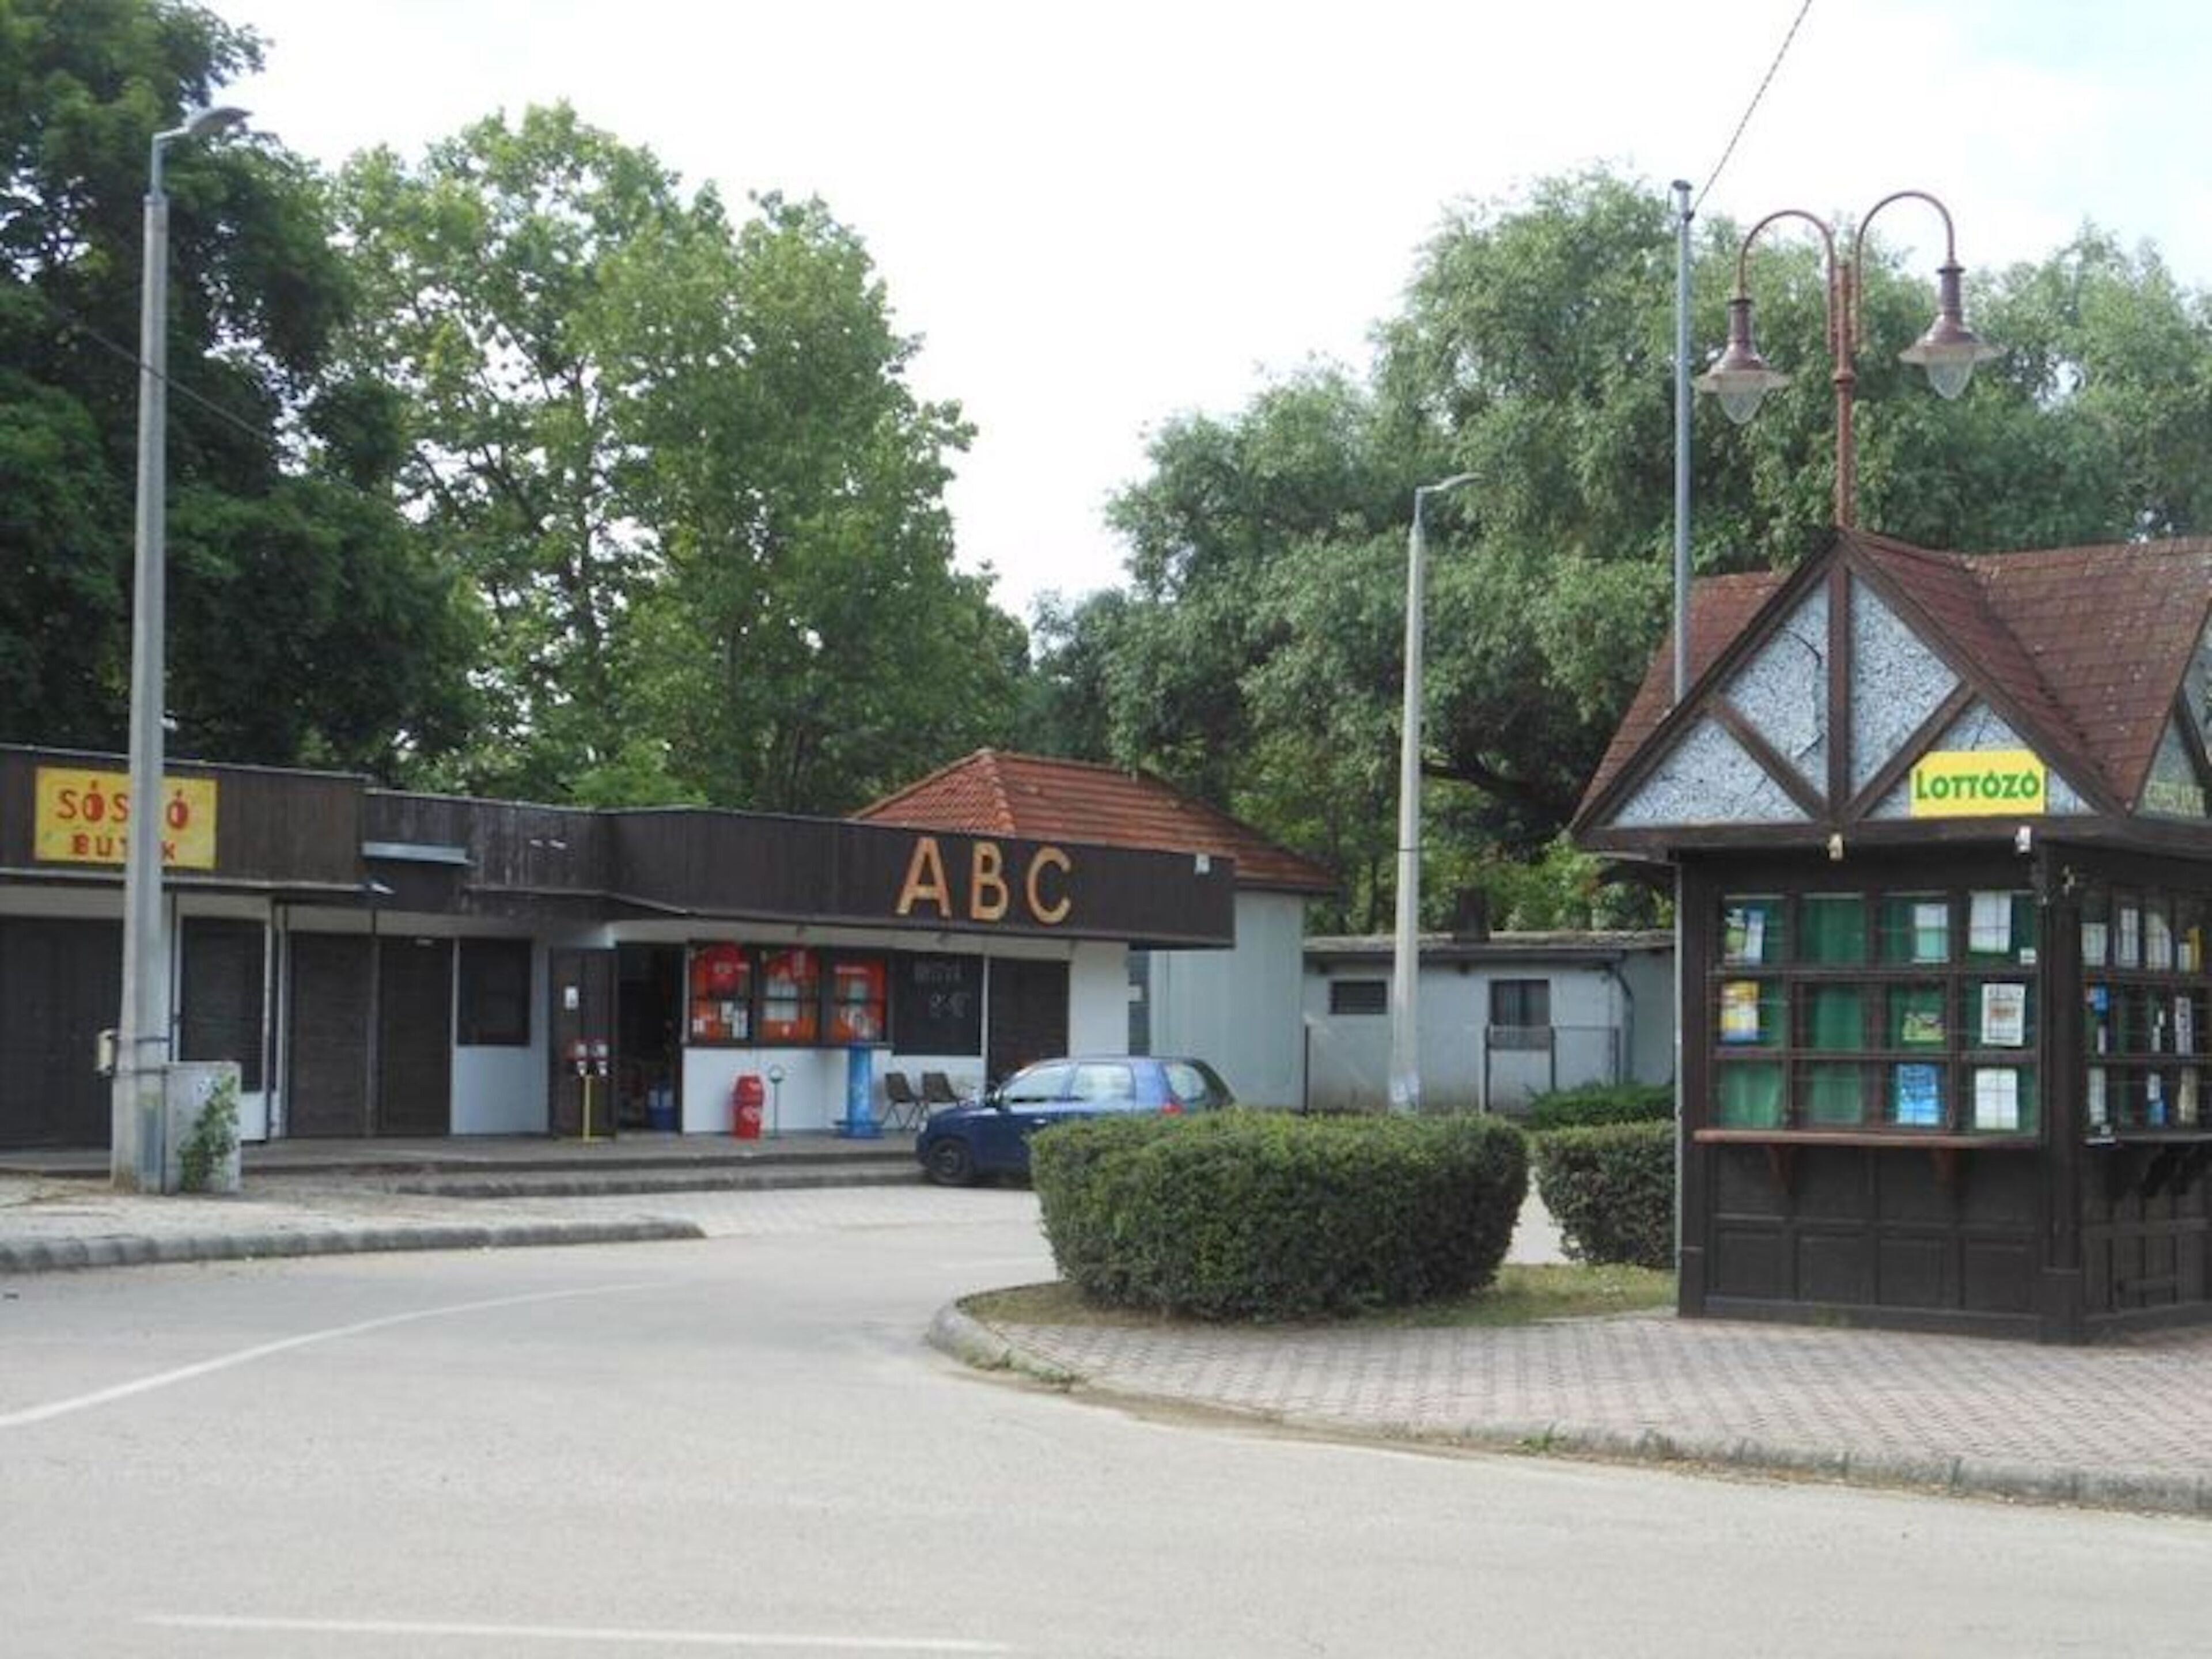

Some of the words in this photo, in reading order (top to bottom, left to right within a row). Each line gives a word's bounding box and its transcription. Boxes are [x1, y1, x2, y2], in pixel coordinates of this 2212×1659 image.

[1916, 769, 2040, 799] LOTTÓZÓ
[56, 780, 189, 830] SÓSÓ
[73, 834, 175, 861] BUTK
[896, 836, 1071, 925] ABC
